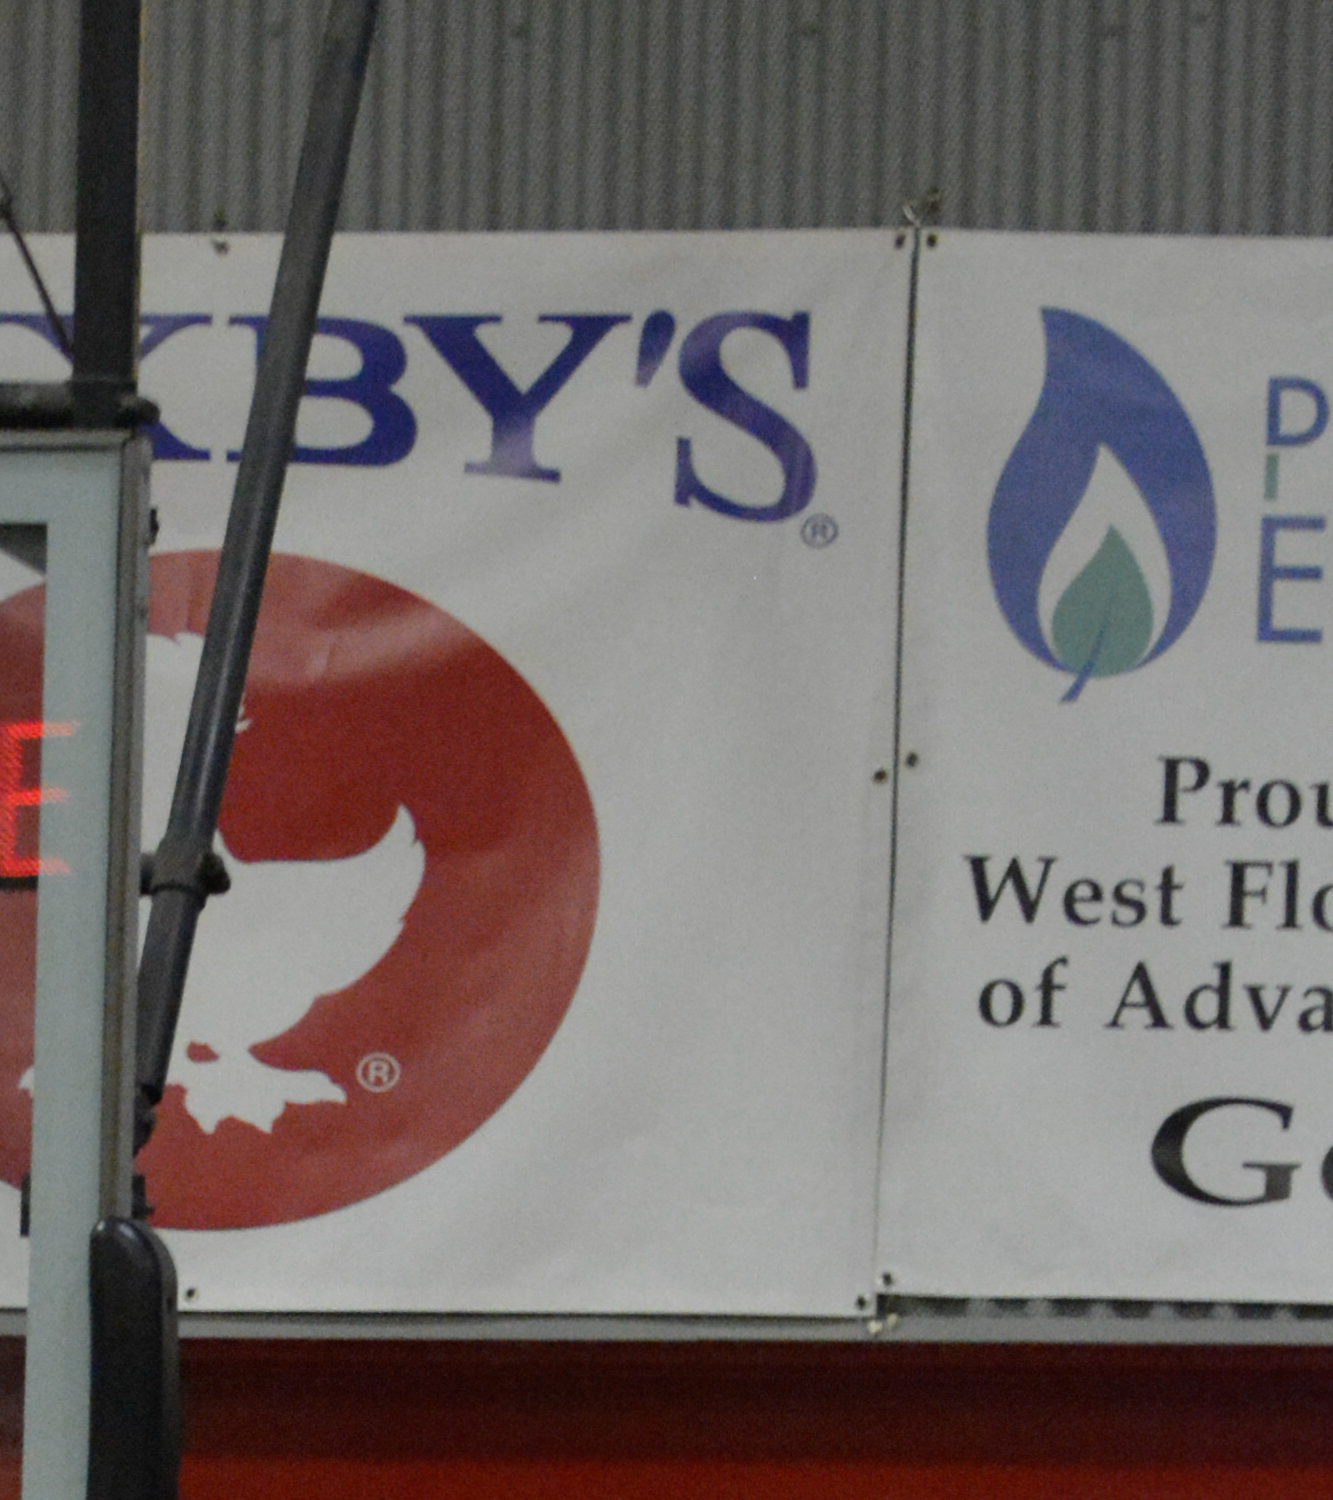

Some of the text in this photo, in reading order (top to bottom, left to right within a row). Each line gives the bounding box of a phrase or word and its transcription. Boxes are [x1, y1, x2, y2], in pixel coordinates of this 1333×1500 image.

[962, 854, 1185, 926] West
[978, 956, 1069, 1027] of
[1151, 1096, 1333, 1208] G
